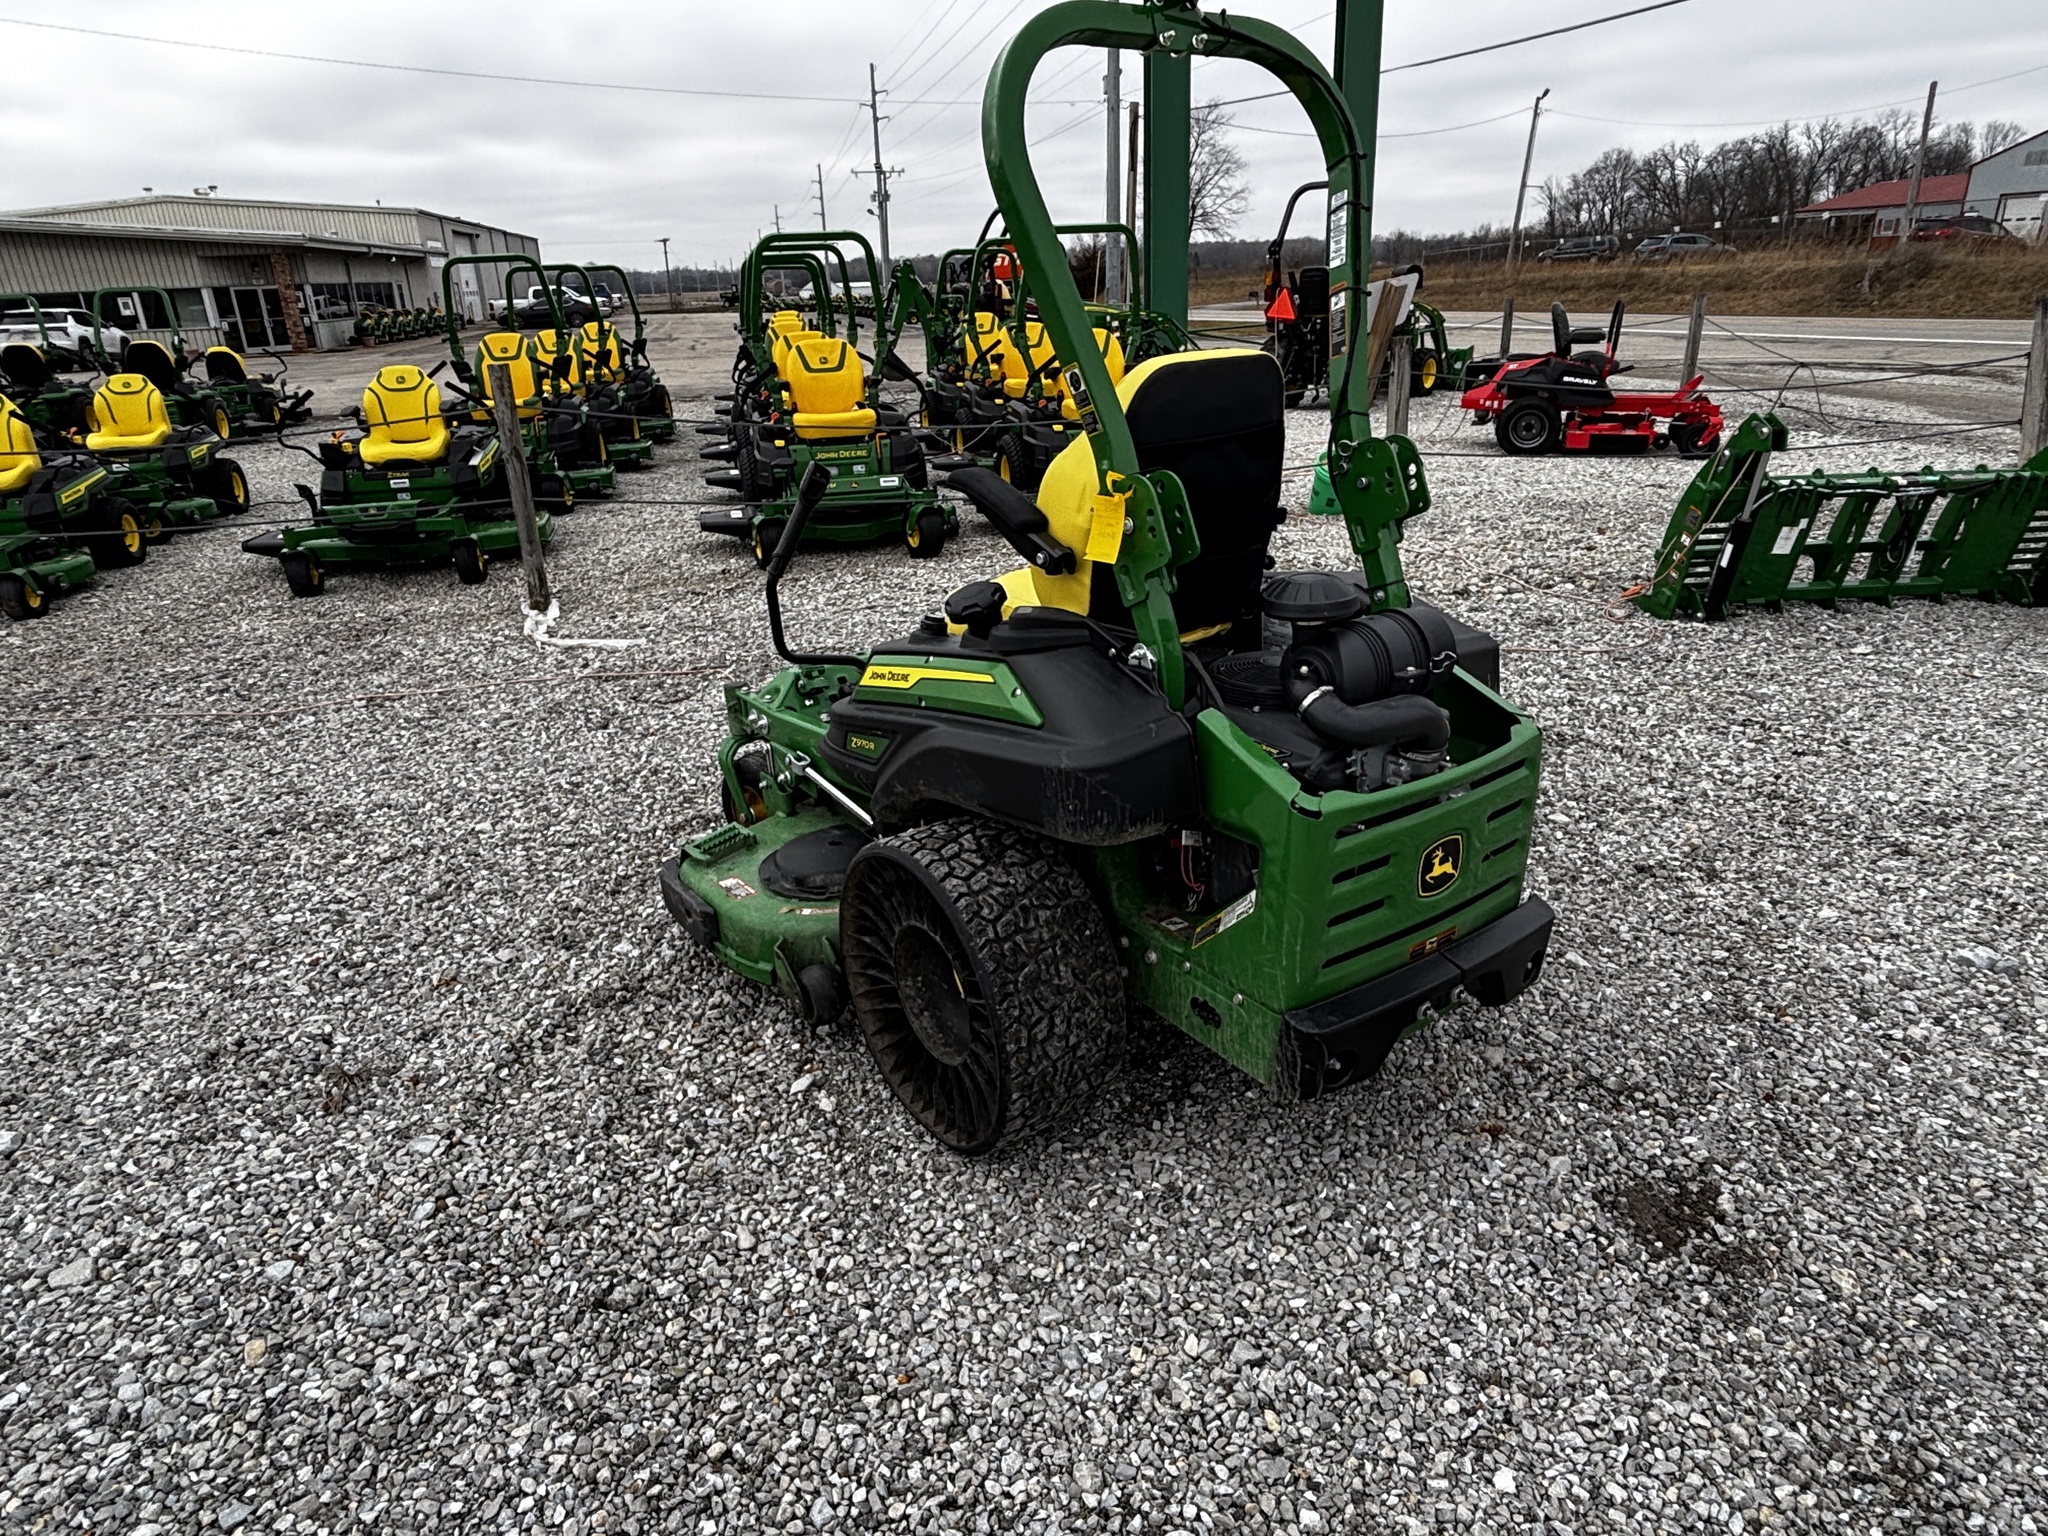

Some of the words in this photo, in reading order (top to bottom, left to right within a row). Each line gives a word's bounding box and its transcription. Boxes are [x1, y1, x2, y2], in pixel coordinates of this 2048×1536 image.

[1563, 376, 1597, 385] GRAVELY
[839, 450, 867, 458] DEERE
[869, 670, 886, 680] JOHN
[888, 671, 910, 682] DEERE
[851, 737, 875, 750] Z970R
